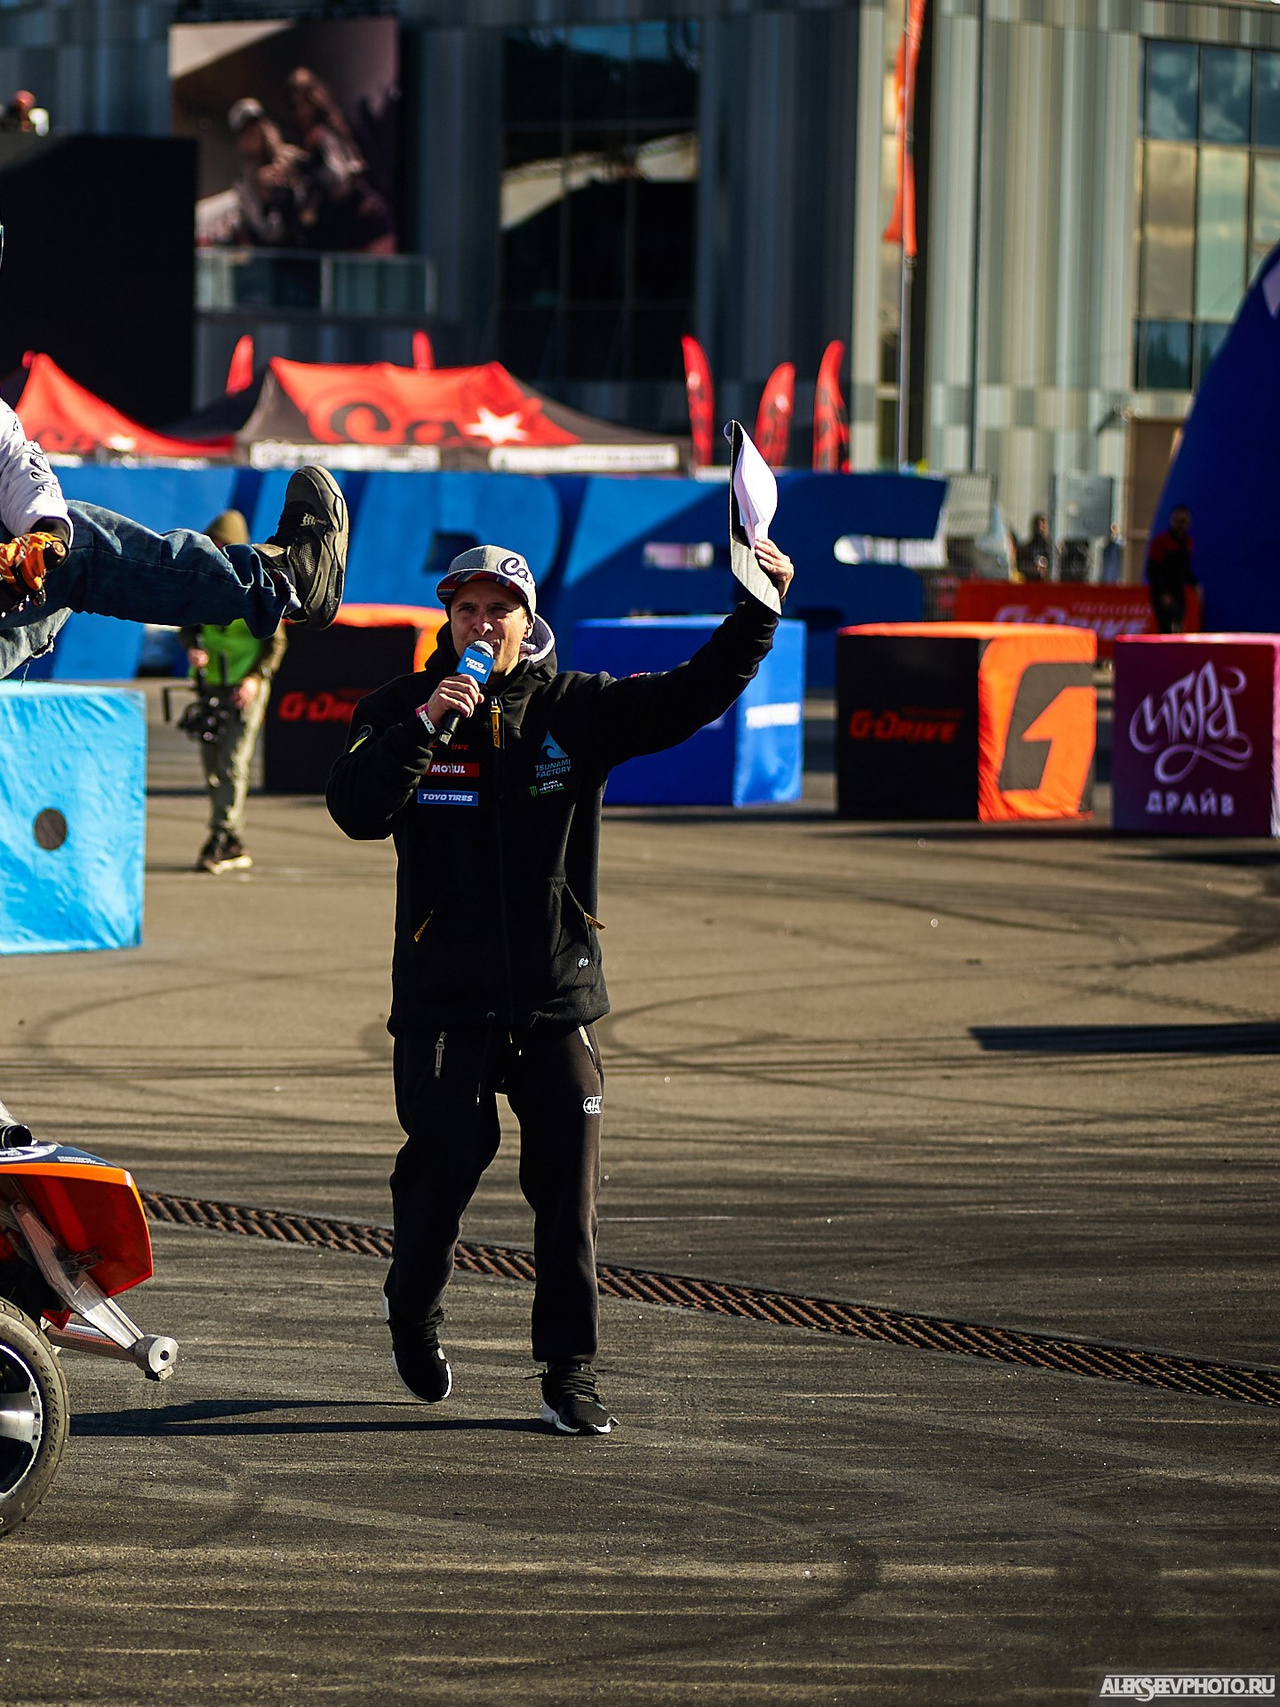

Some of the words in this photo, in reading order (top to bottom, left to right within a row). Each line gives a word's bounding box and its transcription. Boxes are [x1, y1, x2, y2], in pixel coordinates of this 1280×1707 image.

[534, 759, 571, 772] TSUNAMI
[536, 766, 572, 779] FACTORY
[423, 793, 447, 801] TOYO
[448, 794, 474, 802] TIRES
[1145, 788, 1235, 817] ДРАЙВ
